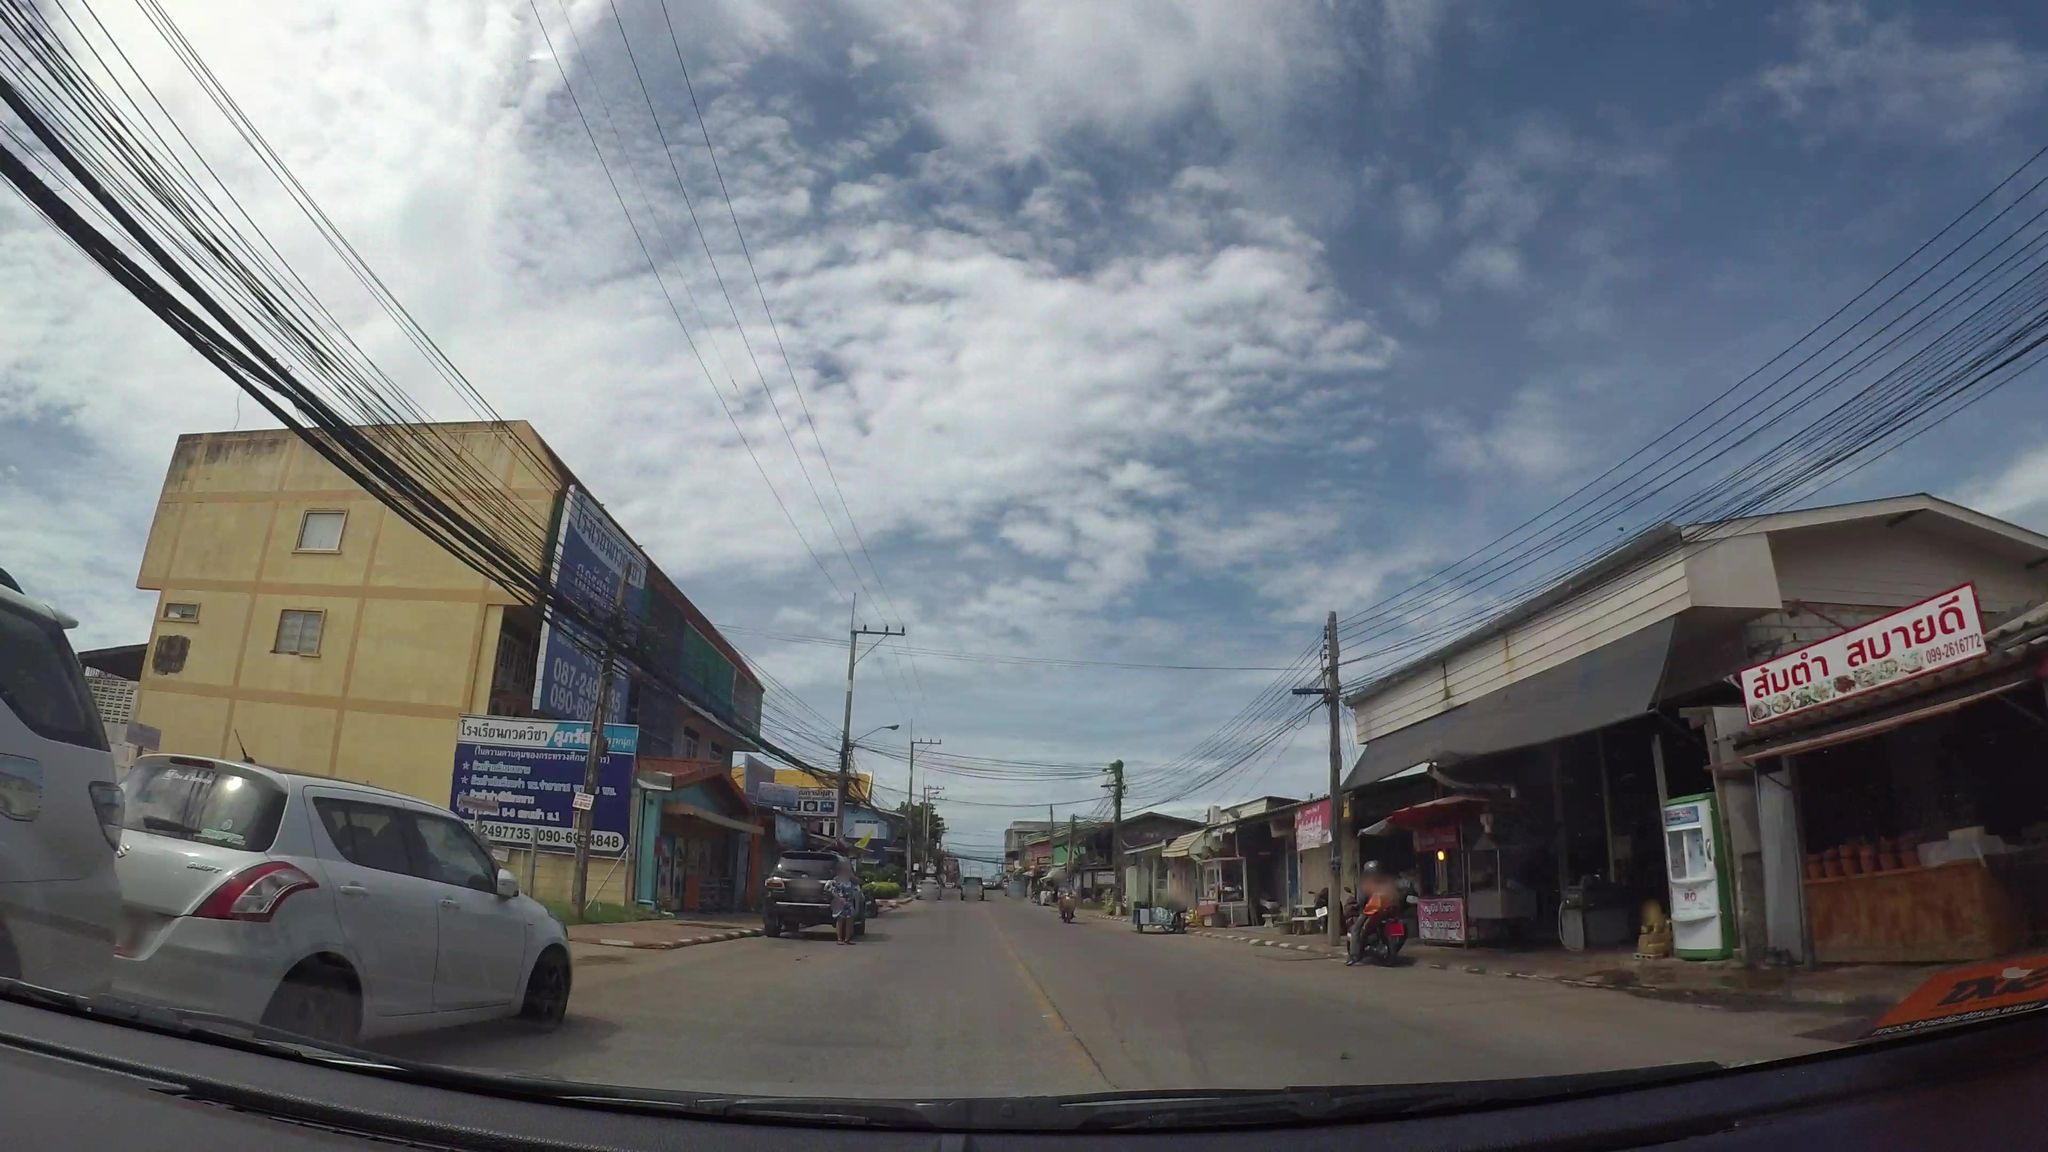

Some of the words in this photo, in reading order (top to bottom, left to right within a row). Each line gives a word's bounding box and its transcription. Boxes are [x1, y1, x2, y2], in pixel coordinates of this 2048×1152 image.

[1753, 650, 1829, 699] ส้มตำ
[1847, 595, 1966, 667] สบายดี
[1925, 633, 1982, 664] 099-2616772
[461, 720, 548, 742] โรงเรียนกวดวิชา
[538, 829, 619, 848] 090-694848
